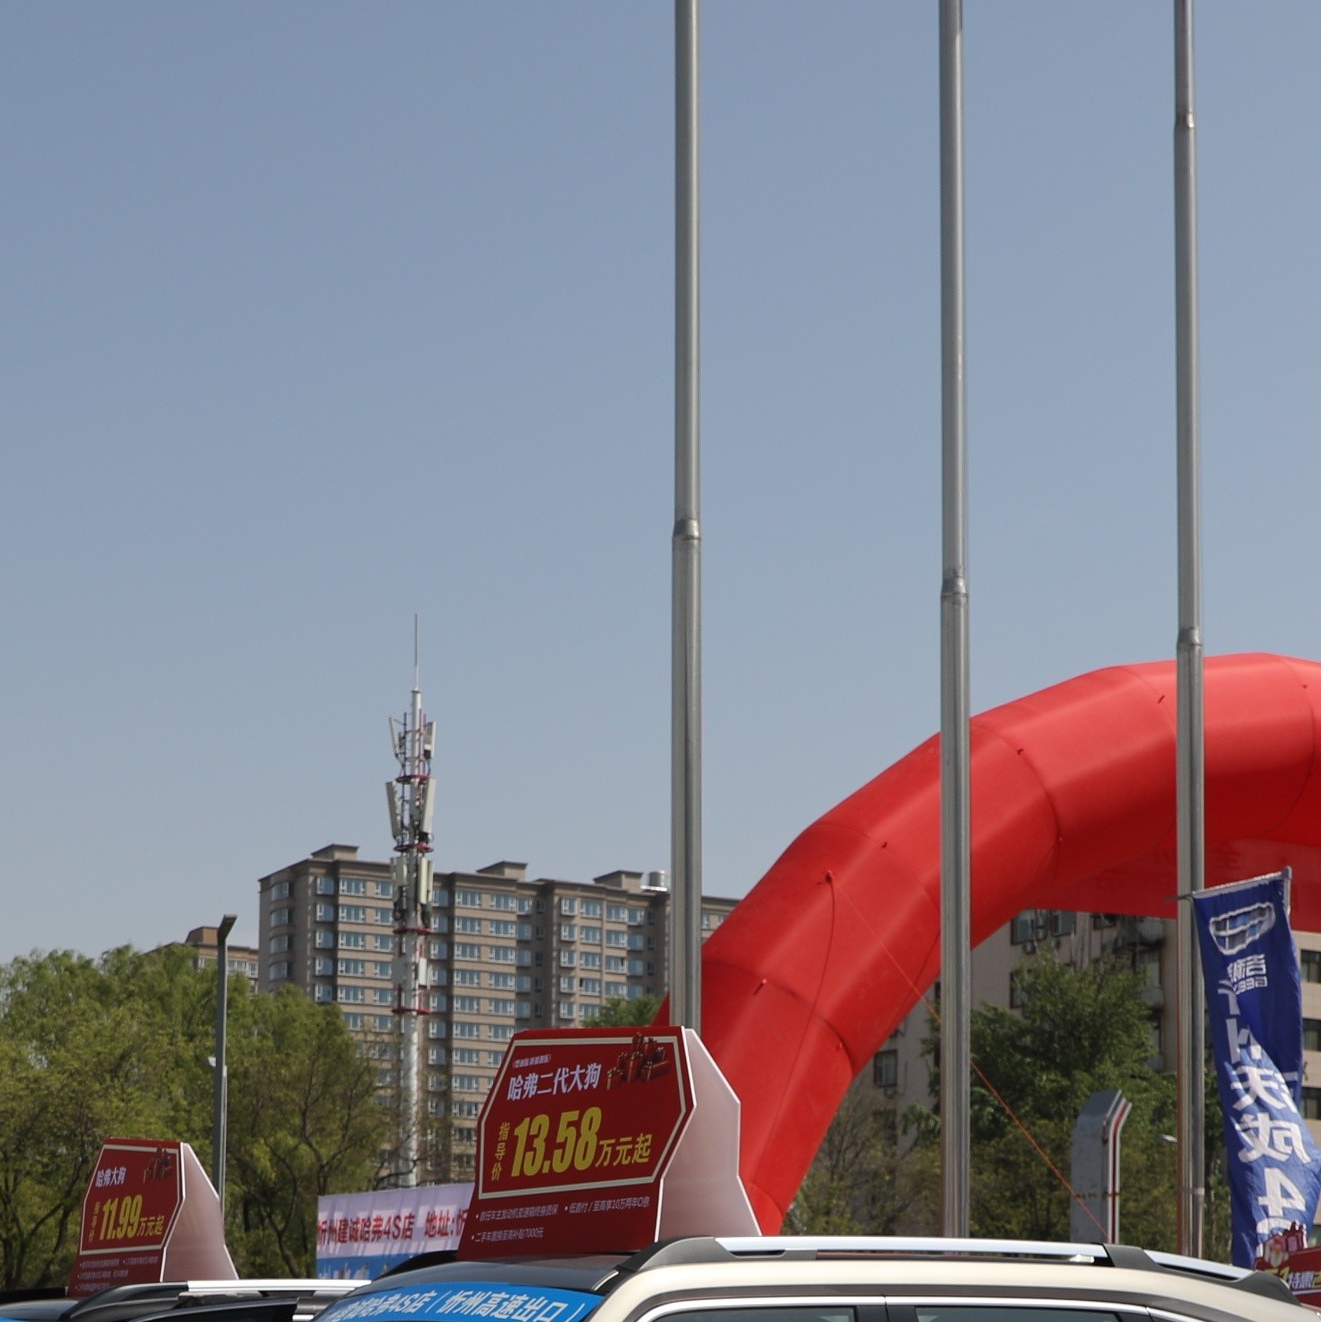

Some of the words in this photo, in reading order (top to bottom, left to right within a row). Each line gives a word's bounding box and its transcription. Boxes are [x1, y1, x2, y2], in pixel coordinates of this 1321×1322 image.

[507, 1062, 601, 1101] 哈弗二代大狗
[491, 1121, 510, 1182] 指导价
[511, 1106, 652, 1178] 13.58万元起
[317, 1214, 415, 1246] 忻州建诚哈弗4S店
